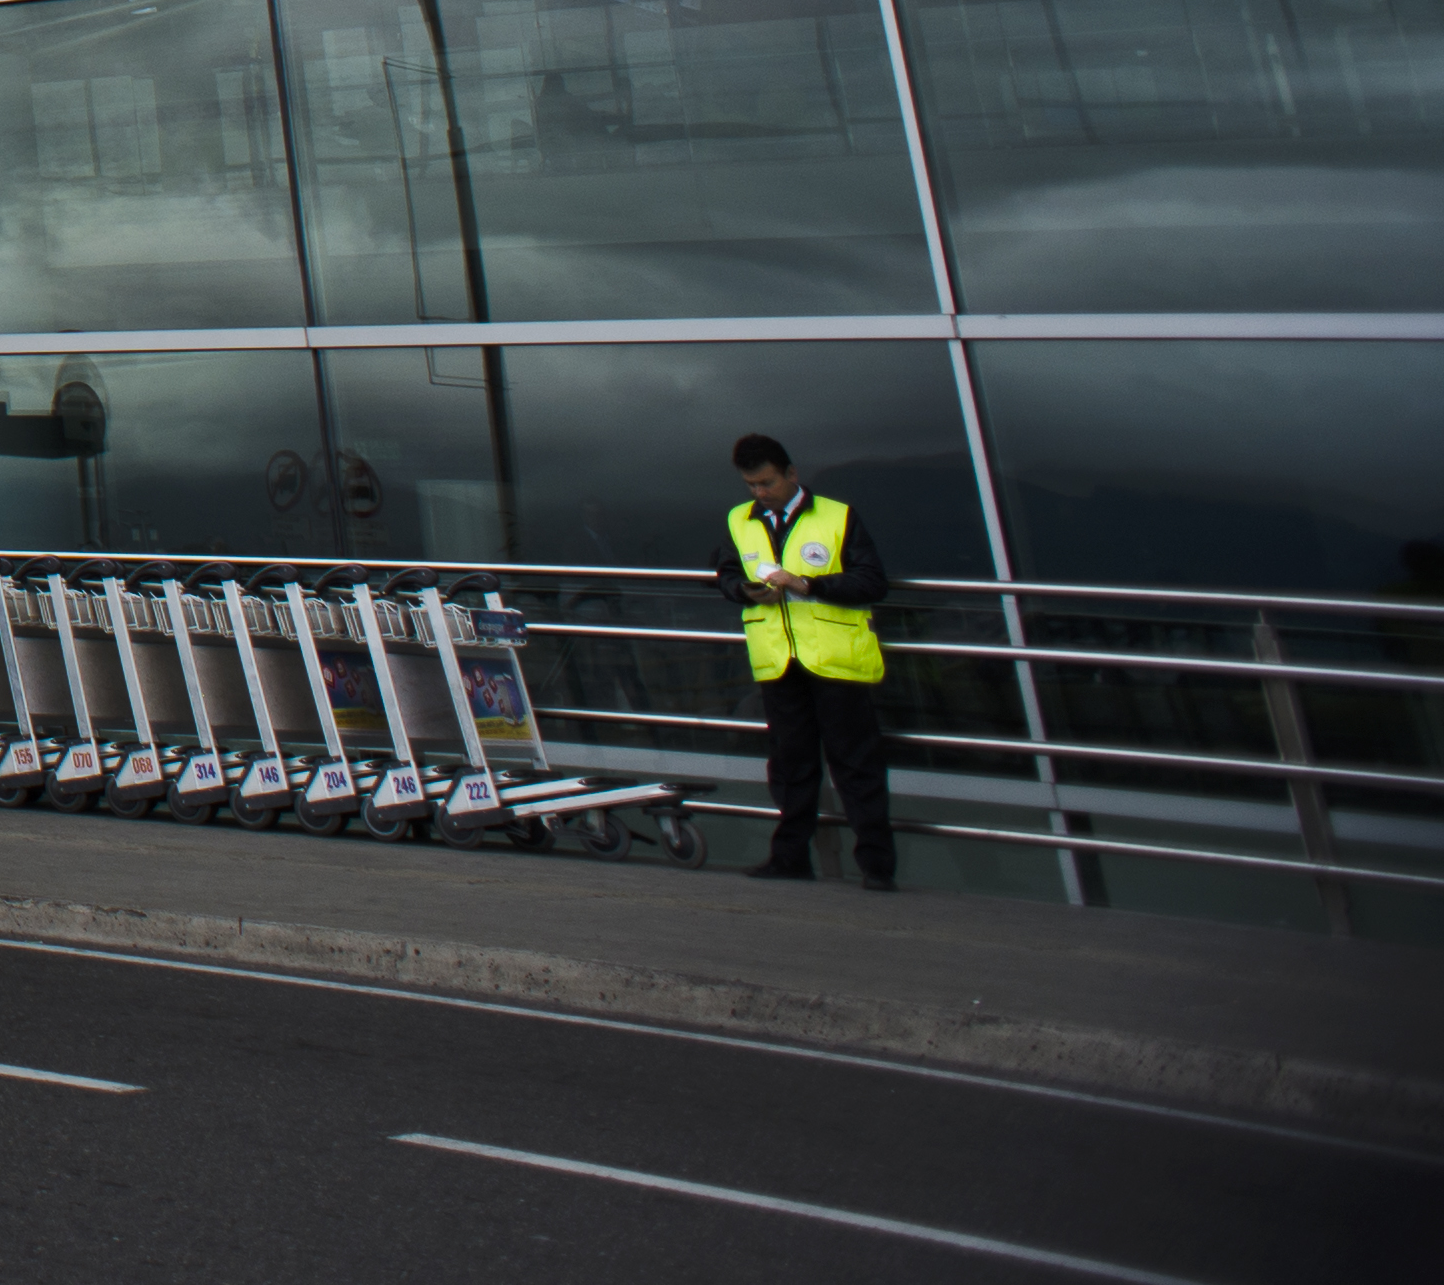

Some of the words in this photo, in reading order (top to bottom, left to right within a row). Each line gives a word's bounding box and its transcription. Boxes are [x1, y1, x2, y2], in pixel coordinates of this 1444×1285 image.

[14, 748, 34, 764] 155
[72, 752, 93, 769] 070
[132, 757, 153, 774] 068
[194, 763, 216, 780] 314
[258, 766, 279, 783] 146
[324, 771, 347, 789] 204
[393, 776, 416, 794] 246
[466, 782, 491, 801] 222
